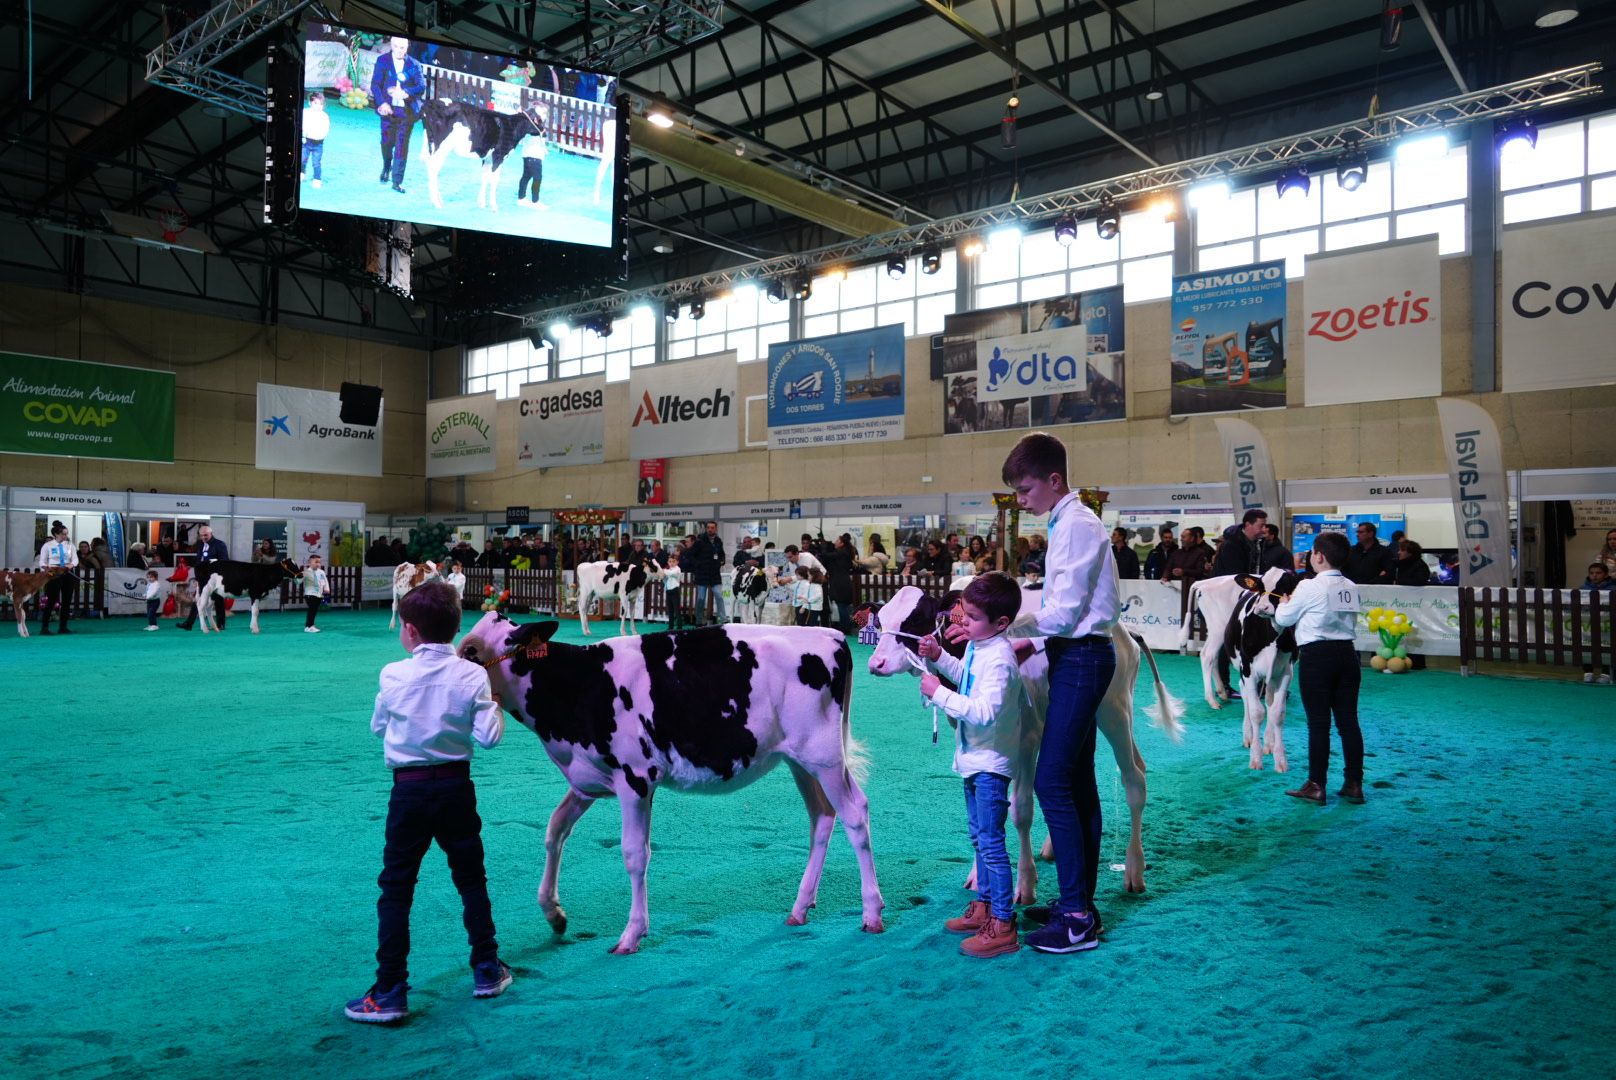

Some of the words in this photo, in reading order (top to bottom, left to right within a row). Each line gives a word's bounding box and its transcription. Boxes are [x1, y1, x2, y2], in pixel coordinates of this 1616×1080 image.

[1176, 266, 1281, 294] ASIMOTO
[1201, 289, 1234, 300] LUBRICANTE
[1235, 286, 1251, 294] PARA
[1260, 282, 1282, 290] MOTOR
[1192, 303, 1213, 313] 957
[1217, 300, 1237, 309] 772
[1240, 296, 1263, 306] 530
[1308, 290, 1430, 342] zoetis
[1016, 352, 1077, 385] dta
[768, 351, 792, 408] HORMIGONES
[824, 352, 838, 370] SAN
[833, 371, 842, 405] ROQUE
[3, 376, 84, 399] Alimentación
[89, 386, 136, 404] Animal
[23, 401, 118, 427] COVAP
[631, 387, 731, 427] Alltech
[785, 406, 799, 414] DOS
[800, 403, 825, 413] TORRES
[27, 430, 113, 443] www.agrocovap.es
[308, 424, 375, 440] AgroBank
[431, 411, 490, 445] CISTERVALL
[1171, 493, 1201, 501] COVIAL
[1386, 486, 1418, 494] LAVAL
[1338, 590, 1352, 604] 10
[1142, 616, 1161, 625] SCA
